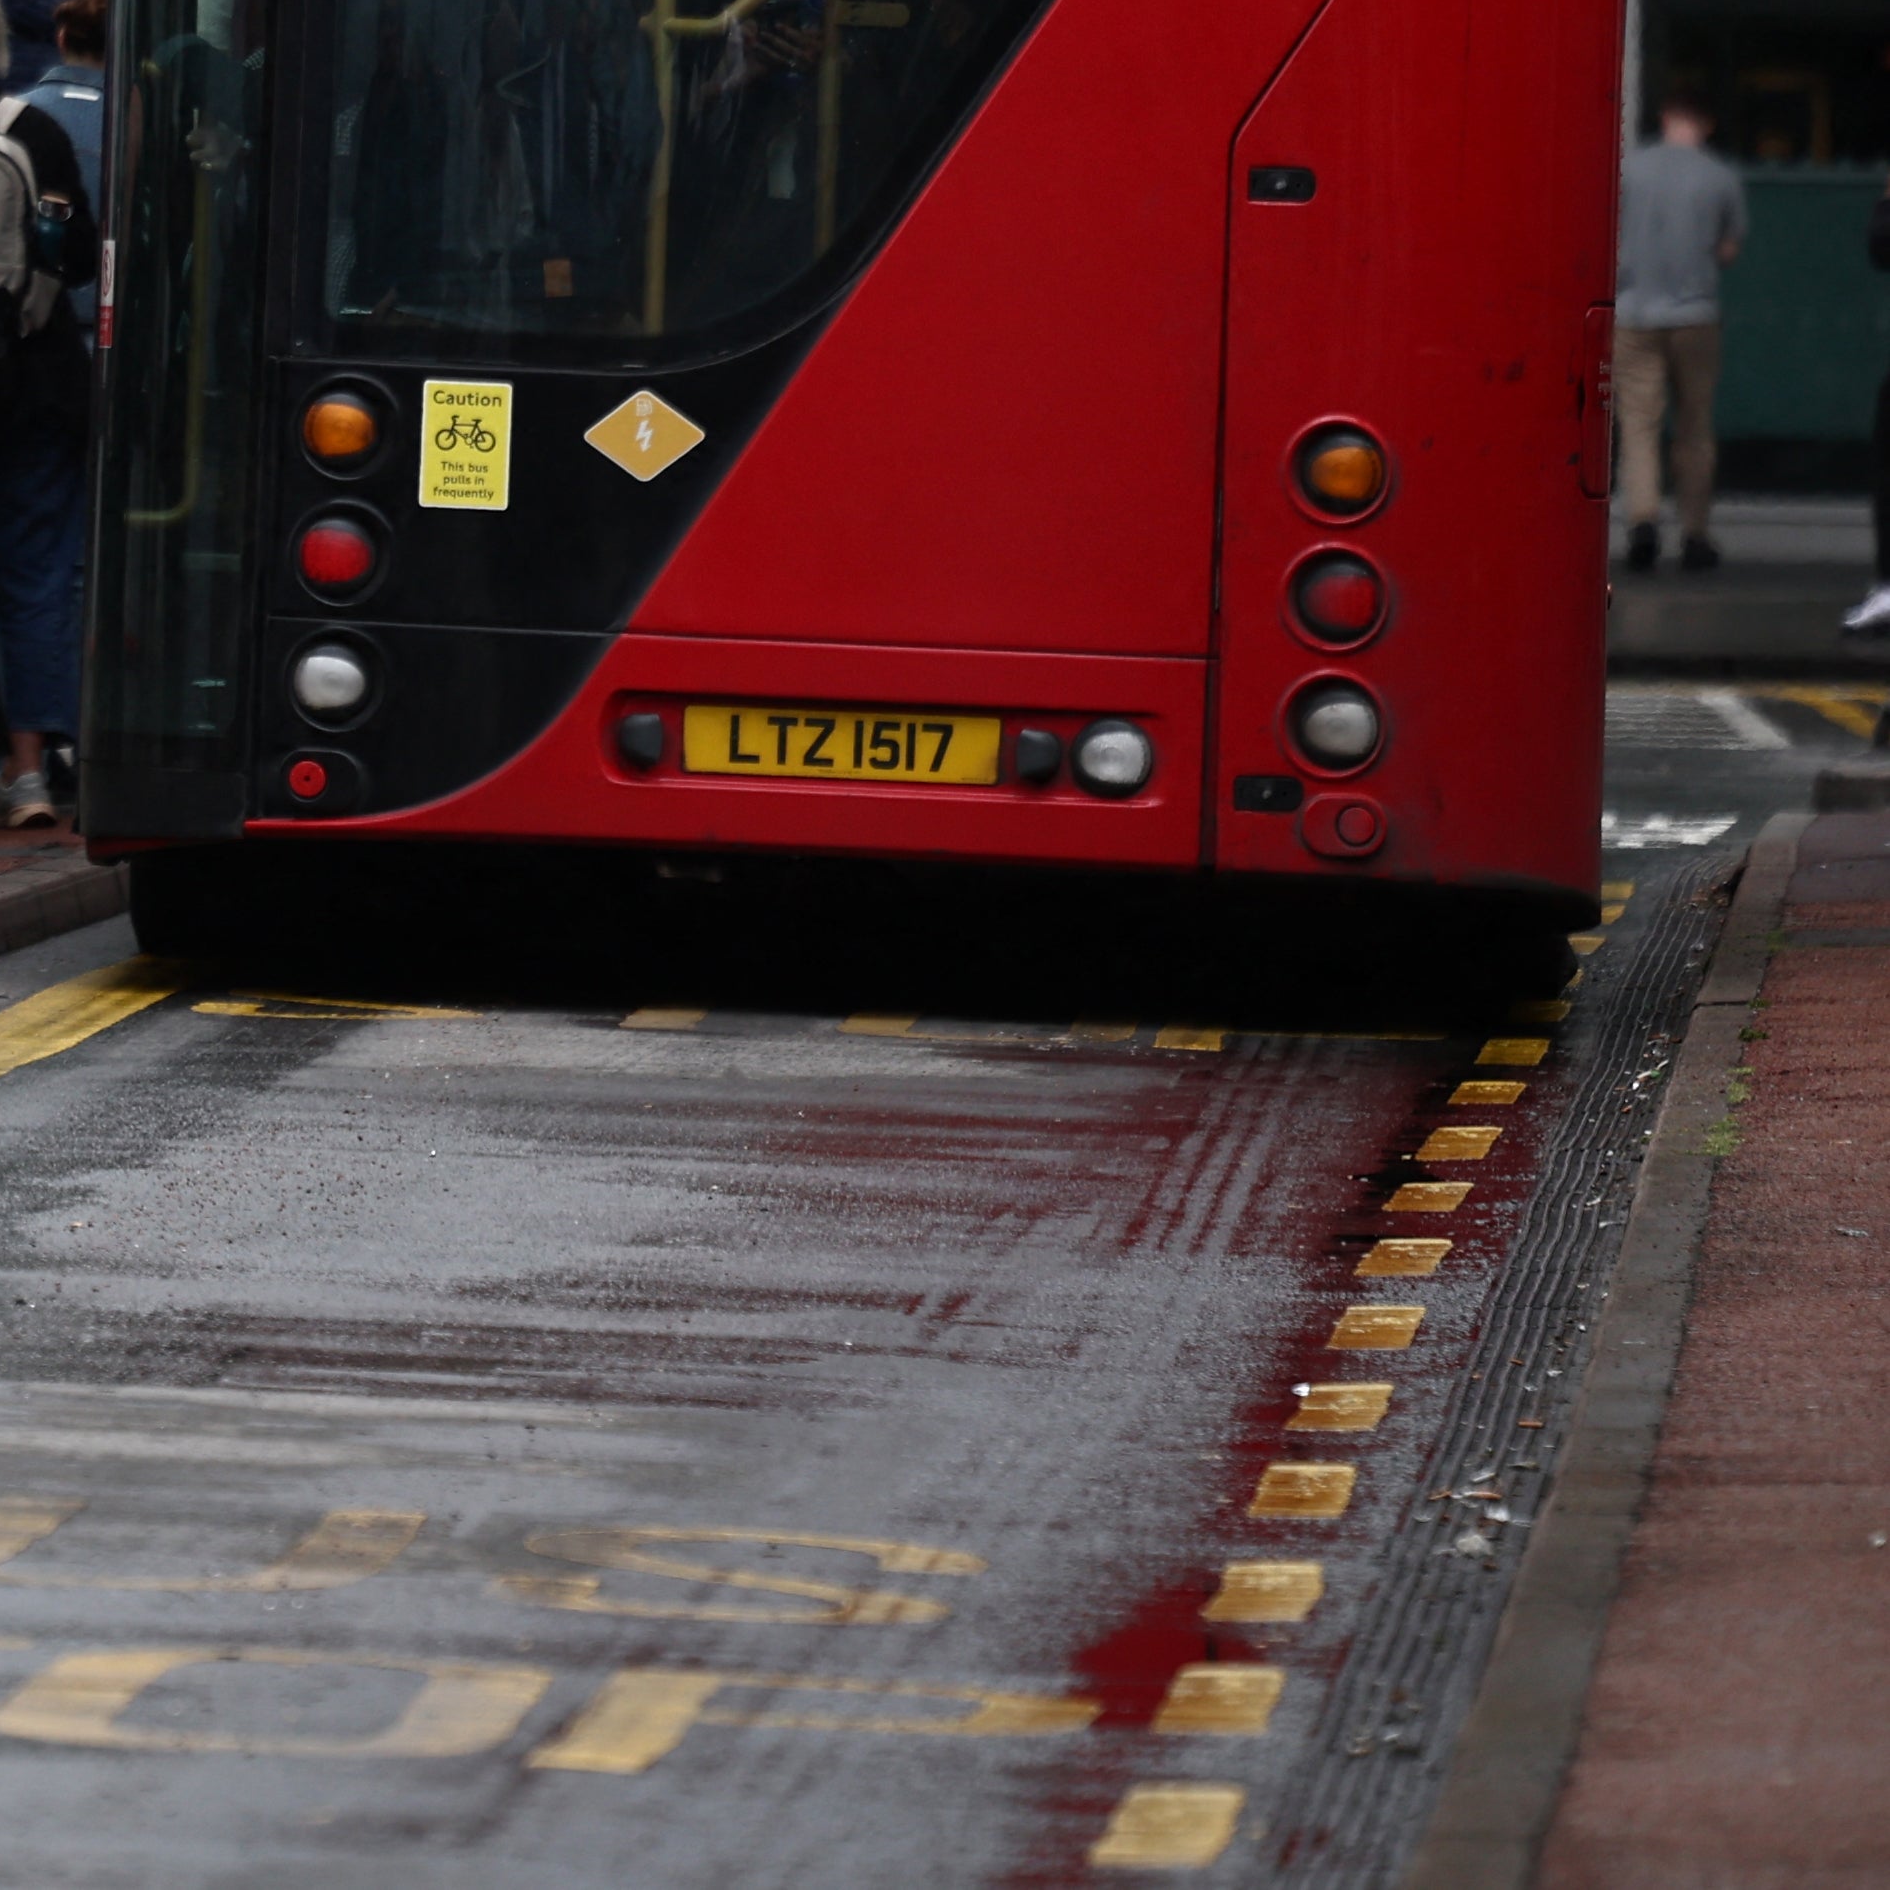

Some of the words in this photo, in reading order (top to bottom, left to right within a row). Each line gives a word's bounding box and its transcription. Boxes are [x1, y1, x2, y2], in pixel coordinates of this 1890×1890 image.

[433, 390, 502, 407] Caution
[441, 461, 465, 472] This
[468, 462, 489, 473] bus
[443, 475, 472, 486] pulls
[474, 475, 485, 486] in
[433, 486, 495, 501] frequently
[728, 714, 836, 768] LTZ
[852, 719, 954, 773] 1517
